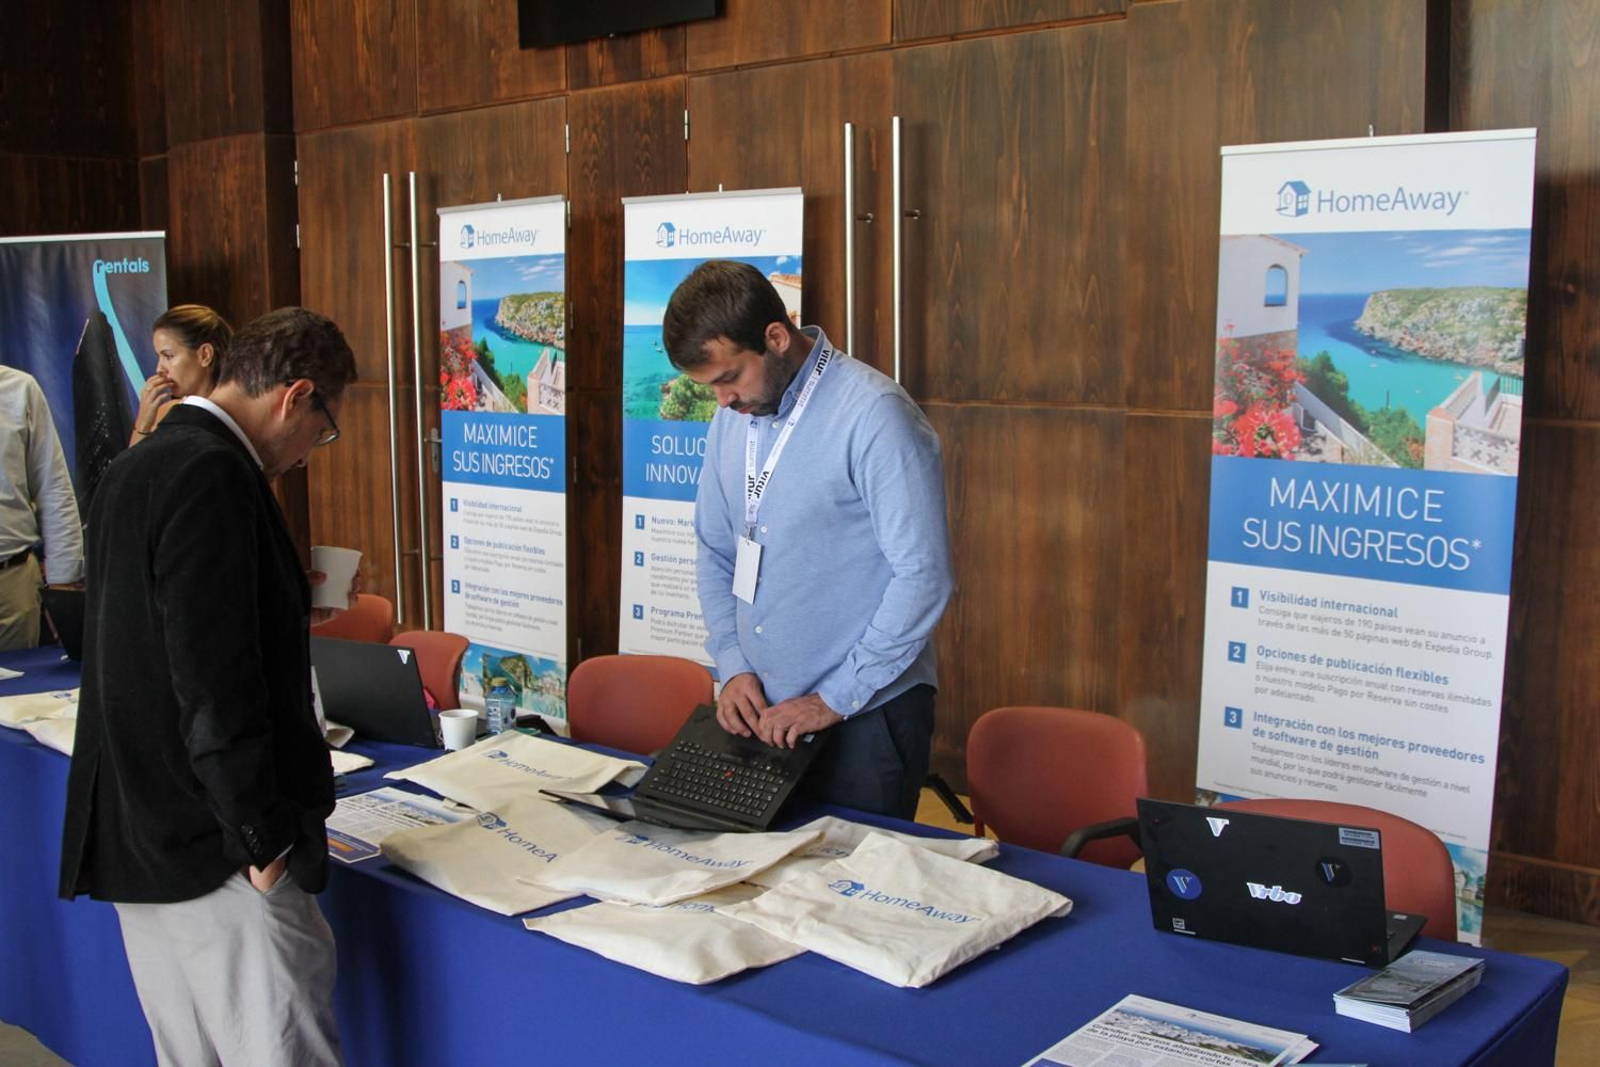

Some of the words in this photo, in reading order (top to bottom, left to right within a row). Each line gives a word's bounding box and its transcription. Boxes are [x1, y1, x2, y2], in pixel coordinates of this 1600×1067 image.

[1317, 187, 1462, 215] HomeAway
[477, 227, 537, 245] HomeAway
[679, 226, 763, 246] HomeAway
[95, 257, 150, 273] rentals
[464, 423, 538, 448] MAXIMICE
[651, 435, 707, 457] SOLUC
[453, 451, 480, 473] SUS
[489, 502, 522, 513] internacional
[1270, 477, 1445, 523] MAXIMICE
[651, 516, 676, 525] Nuevo:
[677, 518, 695, 527] Mark
[464, 536, 484, 548] Opciones
[486, 539, 492, 547] de
[522, 543, 545, 554] flexibles
[1242, 518, 1301, 553] SUS
[651, 553, 677, 563] Gestión
[651, 606, 684, 619] Programa
[686, 611, 704, 620] Prem
[1260, 590, 1318, 609] Visibilidad
[1320, 597, 1398, 618] internacional
[1258, 605, 1291, 621] Consiga
[1294, 612, 1308, 623] que
[1310, 612, 1342, 627] viajeros
[1344, 616, 1355, 626] de
[1358, 618, 1372, 629] 190
[1404, 626, 1425, 635] vean
[1428, 629, 1438, 637] su
[1440, 628, 1477, 642] anuncio
[1258, 617, 1283, 630] través
[1285, 621, 1295, 631] de
[1297, 622, 1309, 633] las
[1312, 624, 1328, 636] más
[1330, 627, 1342, 637] de
[1344, 628, 1354, 639] 50
[1356, 630, 1389, 646] páginas
[1391, 635, 1409, 647] web
[1411, 637, 1422, 648] de
[1425, 639, 1460, 656] Expedia
[1462, 644, 1494, 661] Group.
[1257, 645, 1306, 665] Opciones
[1310, 652, 1323, 665] de
[1326, 655, 1392, 677] publicación
[1396, 665, 1449, 683] flexibles
[1254, 687, 1268, 698] por
[1255, 674, 1260, 682] o
[1263, 673, 1294, 687] nuestro
[1296, 679, 1325, 692] modelo
[1328, 684, 1348, 698] Pago
[1350, 690, 1364, 700] por
[1368, 690, 1402, 704] Reserva
[1405, 696, 1417, 706] sin
[1420, 699, 1448, 711] costes
[1299, 670, 1314, 679] una
[1317, 670, 1362, 688] suscripción
[1365, 678, 1388, 690] anual
[1390, 684, 1405, 692] con
[1408, 686, 1444, 698] reservas
[1447, 690, 1492, 705] ilimitadas
[1252, 726, 1266, 738] de
[1268, 729, 1316, 747] software
[1320, 738, 1333, 750] de
[1336, 741, 1378, 760] gestión
[1254, 711, 1313, 735] Integración
[1316, 725, 1335, 736] con
[1338, 726, 1355, 740] los
[1358, 732, 1404, 751] mejores
[1408, 738, 1485, 765] proveedores
[498, 758, 565, 780] HomeAw
[1251, 768, 1262, 777] sus
[1264, 769, 1296, 783] anuncios
[1252, 742, 1294, 760] Trabajamos
[1296, 752, 1309, 761] con
[1312, 753, 1322, 764] los
[1352, 763, 1362, 771] en
[1364, 763, 1397, 778] software
[1400, 770, 1410, 780] de
[1451, 779, 1470, 791] nivel
[1284, 763, 1296, 774] por
[1298, 763, 1304, 773] lo
[1307, 767, 1320, 778] que
[1346, 772, 1382, 790] gestionar
[1205, 816, 1230, 837] V
[497, 828, 559, 864] HomeA
[643, 840, 749, 868] HomeAway
[1172, 876, 1193, 895] V
[1246, 881, 1303, 905] Vrbo
[859, 890, 976, 924] HomeAway
[1092, 1023, 1129, 1036] Grandes
[1132, 1032, 1170, 1047] ingresos
[1172, 1041, 1221, 1059] alquilando
[1235, 1058, 1259, 1067] casa
[1110, 1031, 1135, 1044] playa
[1135, 1039, 1152, 1048] por
[1153, 1042, 1199, 1059] estancias
[1200, 1053, 1232, 1067] cortas
